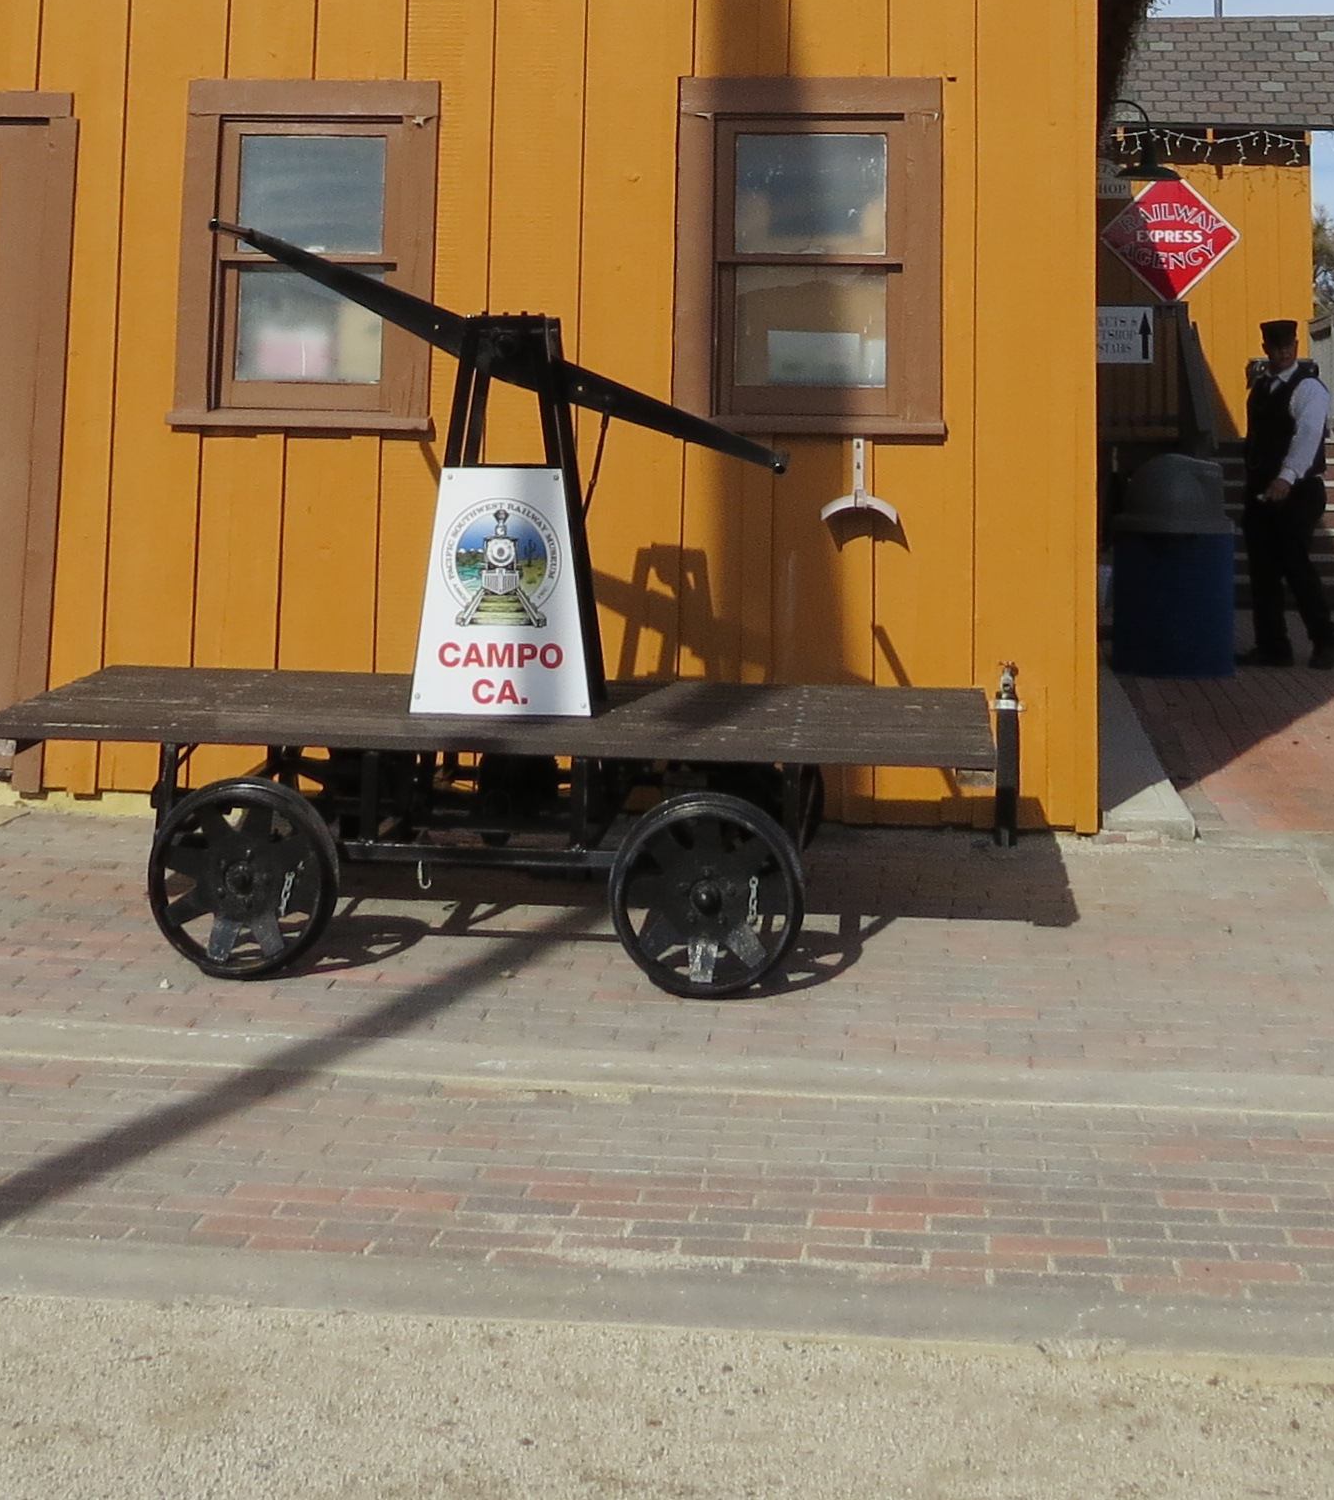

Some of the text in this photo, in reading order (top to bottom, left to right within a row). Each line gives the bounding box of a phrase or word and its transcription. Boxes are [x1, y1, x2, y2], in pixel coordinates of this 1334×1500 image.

[1118, 202, 1226, 235] RAILWAY
[1136, 229, 1203, 244] EXPRESS
[1118, 239, 1216, 270] AGENCY
[445, 503, 558, 580] PACIFIC SOUTHWEST RAILWAY MUSEUM
[437, 642, 564, 670] CAMPO
[471, 678, 529, 706] CA.
